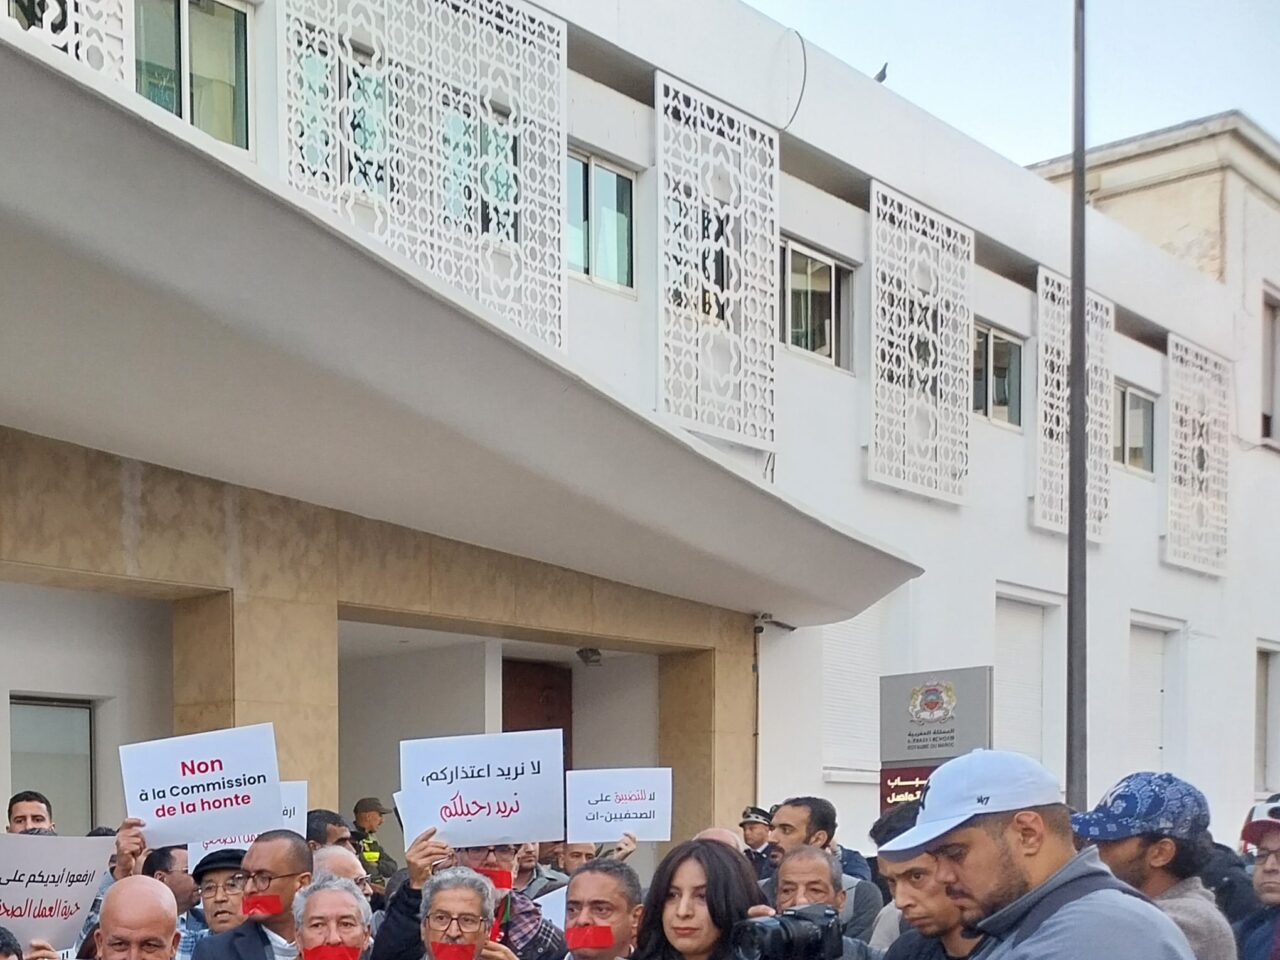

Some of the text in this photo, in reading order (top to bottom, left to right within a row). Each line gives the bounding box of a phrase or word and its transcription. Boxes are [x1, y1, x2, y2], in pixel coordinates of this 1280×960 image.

[180, 758, 223, 777] Non
[496, 762, 525, 780] نريد
[530, 760, 541, 775] لا
[139, 773, 266, 801] à la Commission
[155, 793, 251, 818] de la honte
[440, 790, 520, 822] نريد رحيلكم
[588, 789, 656, 805] لا للتضييق على
[25, 868, 66, 888] أيديكم
[65, 870, 96, 887] ارفعوا
[33, 898, 62, 918] العمل
[60, 900, 81, 919] حرية
